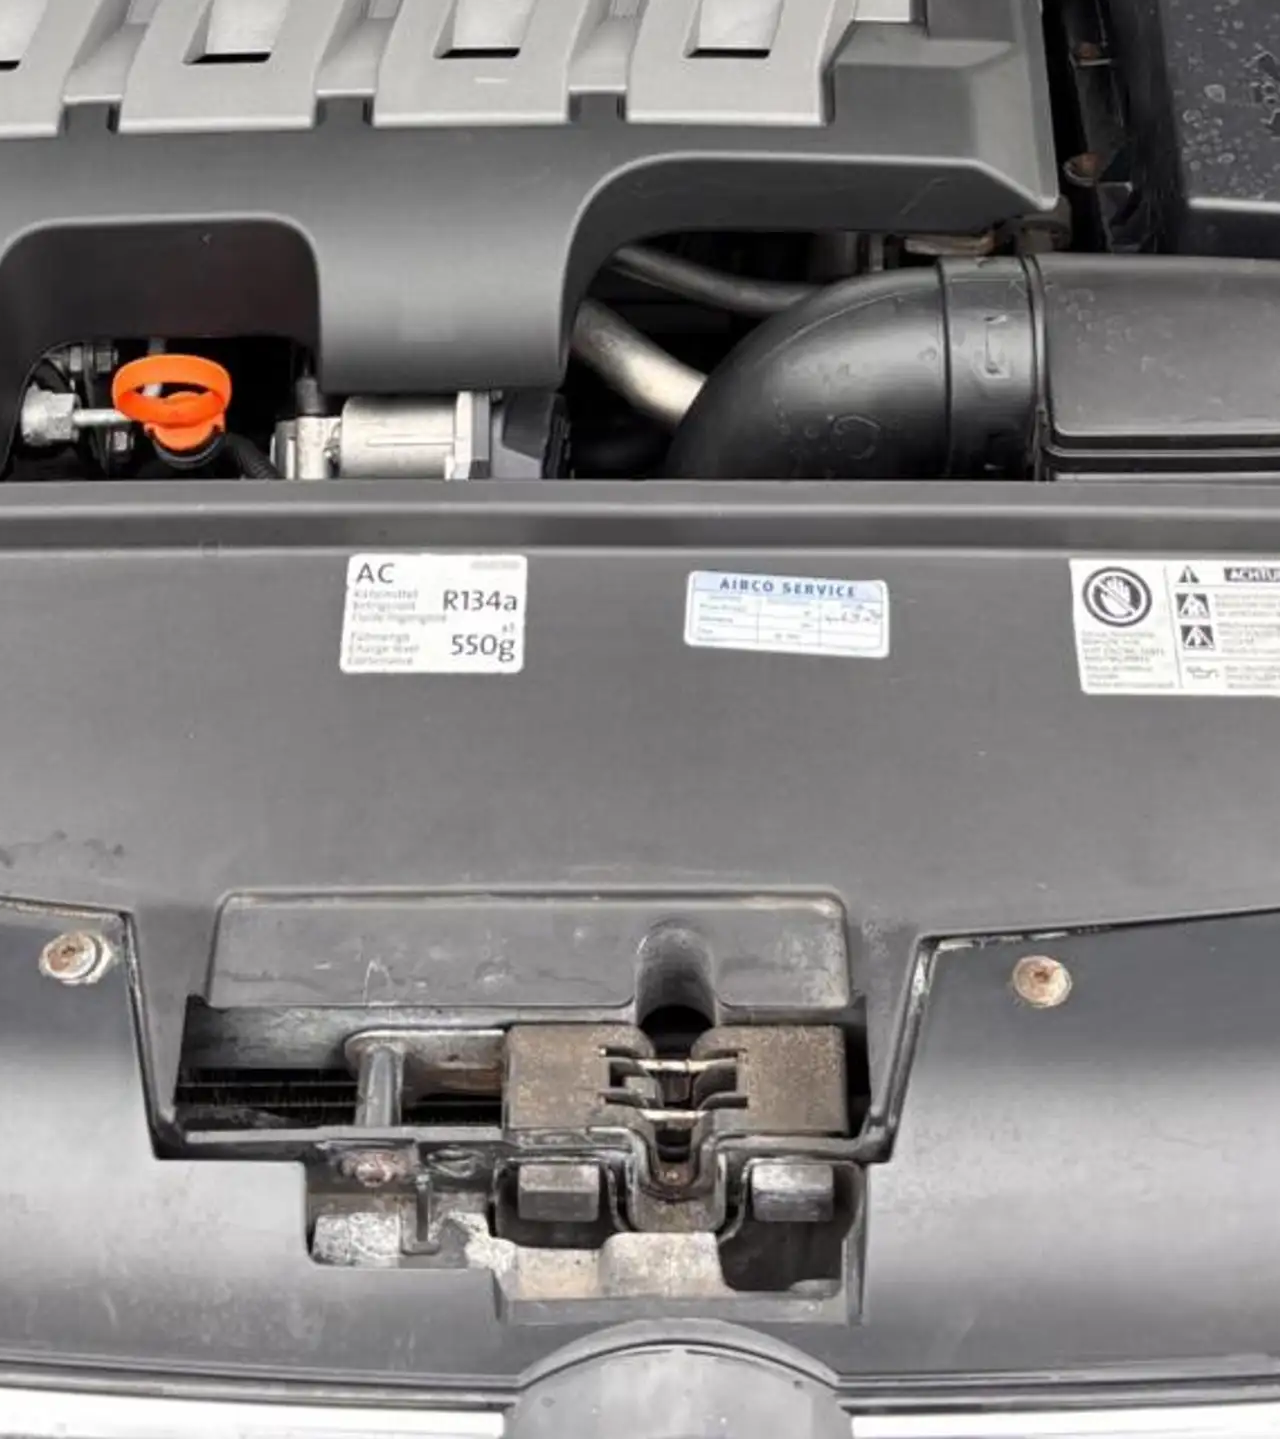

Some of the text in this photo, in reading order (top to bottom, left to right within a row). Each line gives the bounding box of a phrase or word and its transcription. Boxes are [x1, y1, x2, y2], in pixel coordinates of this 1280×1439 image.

[356, 561, 395, 584] AC
[719, 577, 856, 598] AIRCO SERVICE
[442, 589, 518, 612] R134a
[450, 633, 516, 663] 550g
